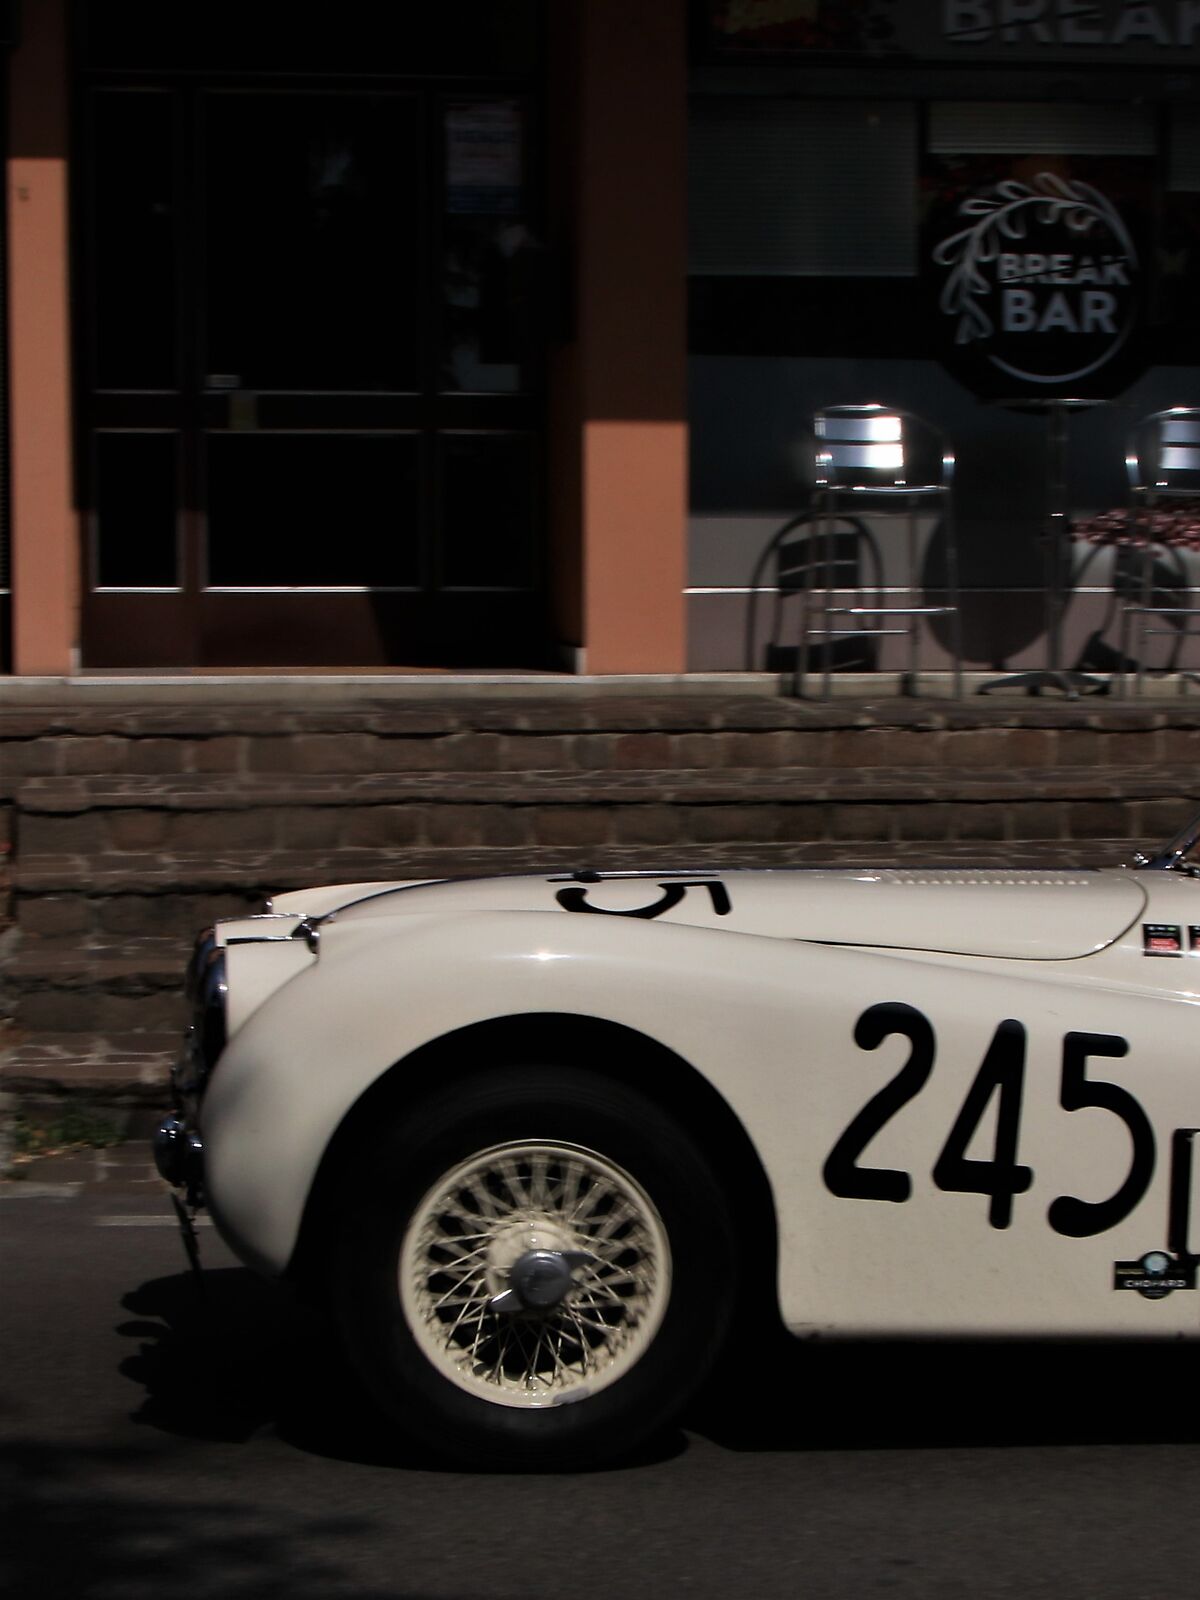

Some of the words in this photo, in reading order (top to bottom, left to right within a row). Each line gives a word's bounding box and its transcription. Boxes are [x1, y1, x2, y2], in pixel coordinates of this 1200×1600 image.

[997, 252, 1132, 286] BREAK
[1000, 288, 1120, 334] BAR
[823, 1000, 1156, 1238] 245
[1122, 1279, 1187, 1288] CHOPARD
